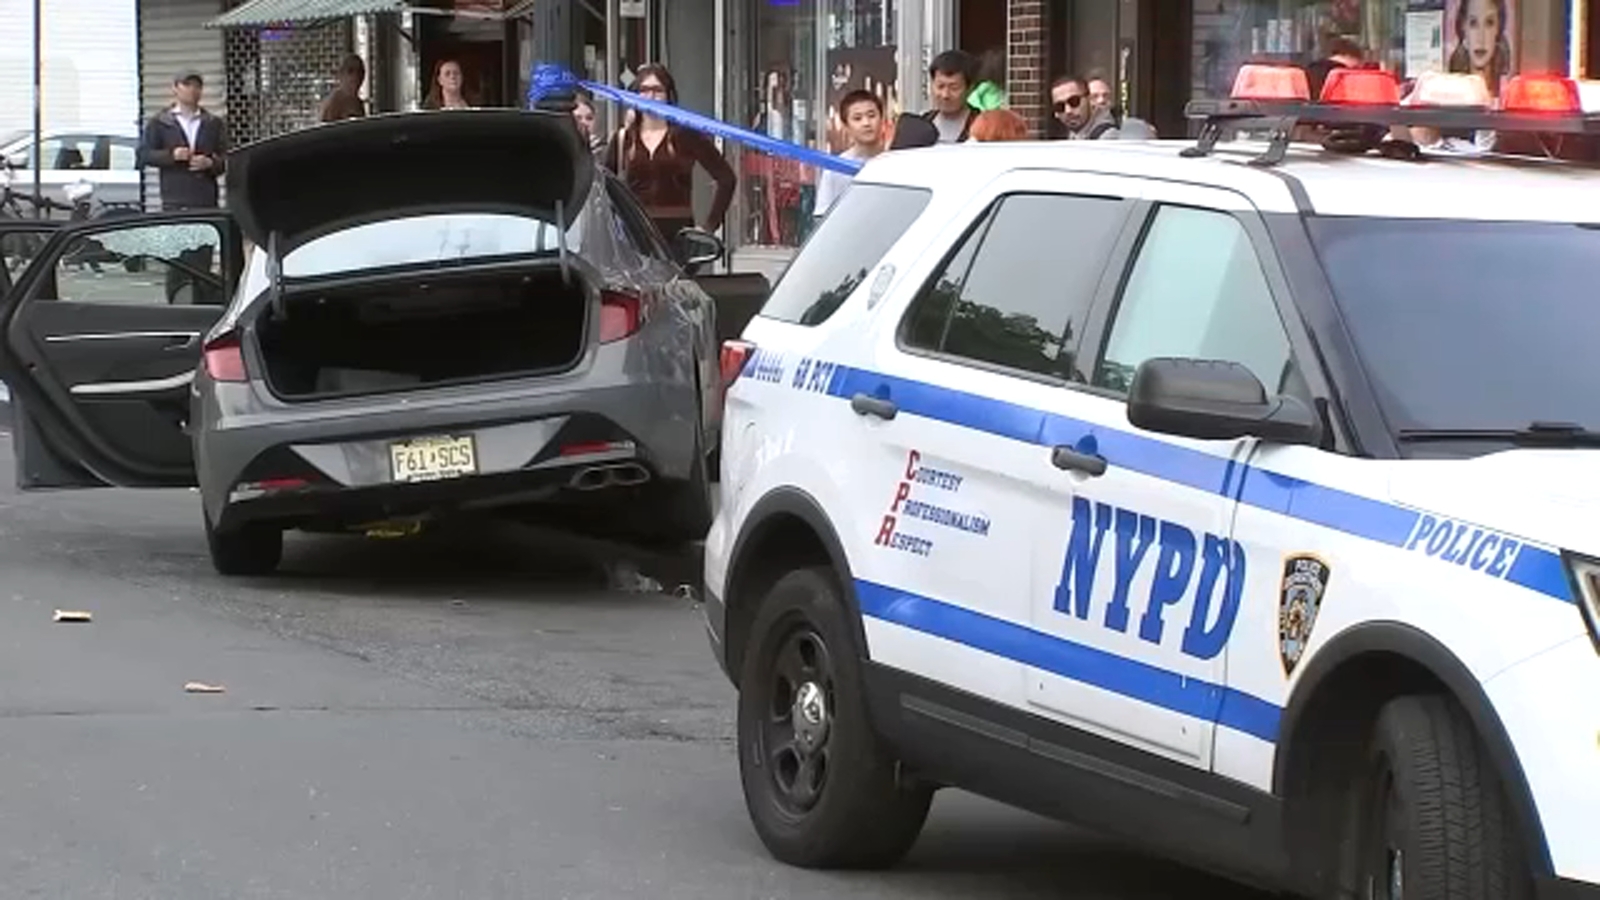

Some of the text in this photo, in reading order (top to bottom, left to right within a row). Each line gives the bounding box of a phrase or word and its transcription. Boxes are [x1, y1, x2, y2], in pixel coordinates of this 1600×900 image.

[806, 358, 834, 394] PCT
[906, 449, 963, 492] COURTESY
[890, 482, 991, 536] PROFESSIONALISM
[874, 515, 933, 557] RESPECT
[1406, 514, 1519, 578] POLICE
[1053, 495, 1246, 660] NYPD
